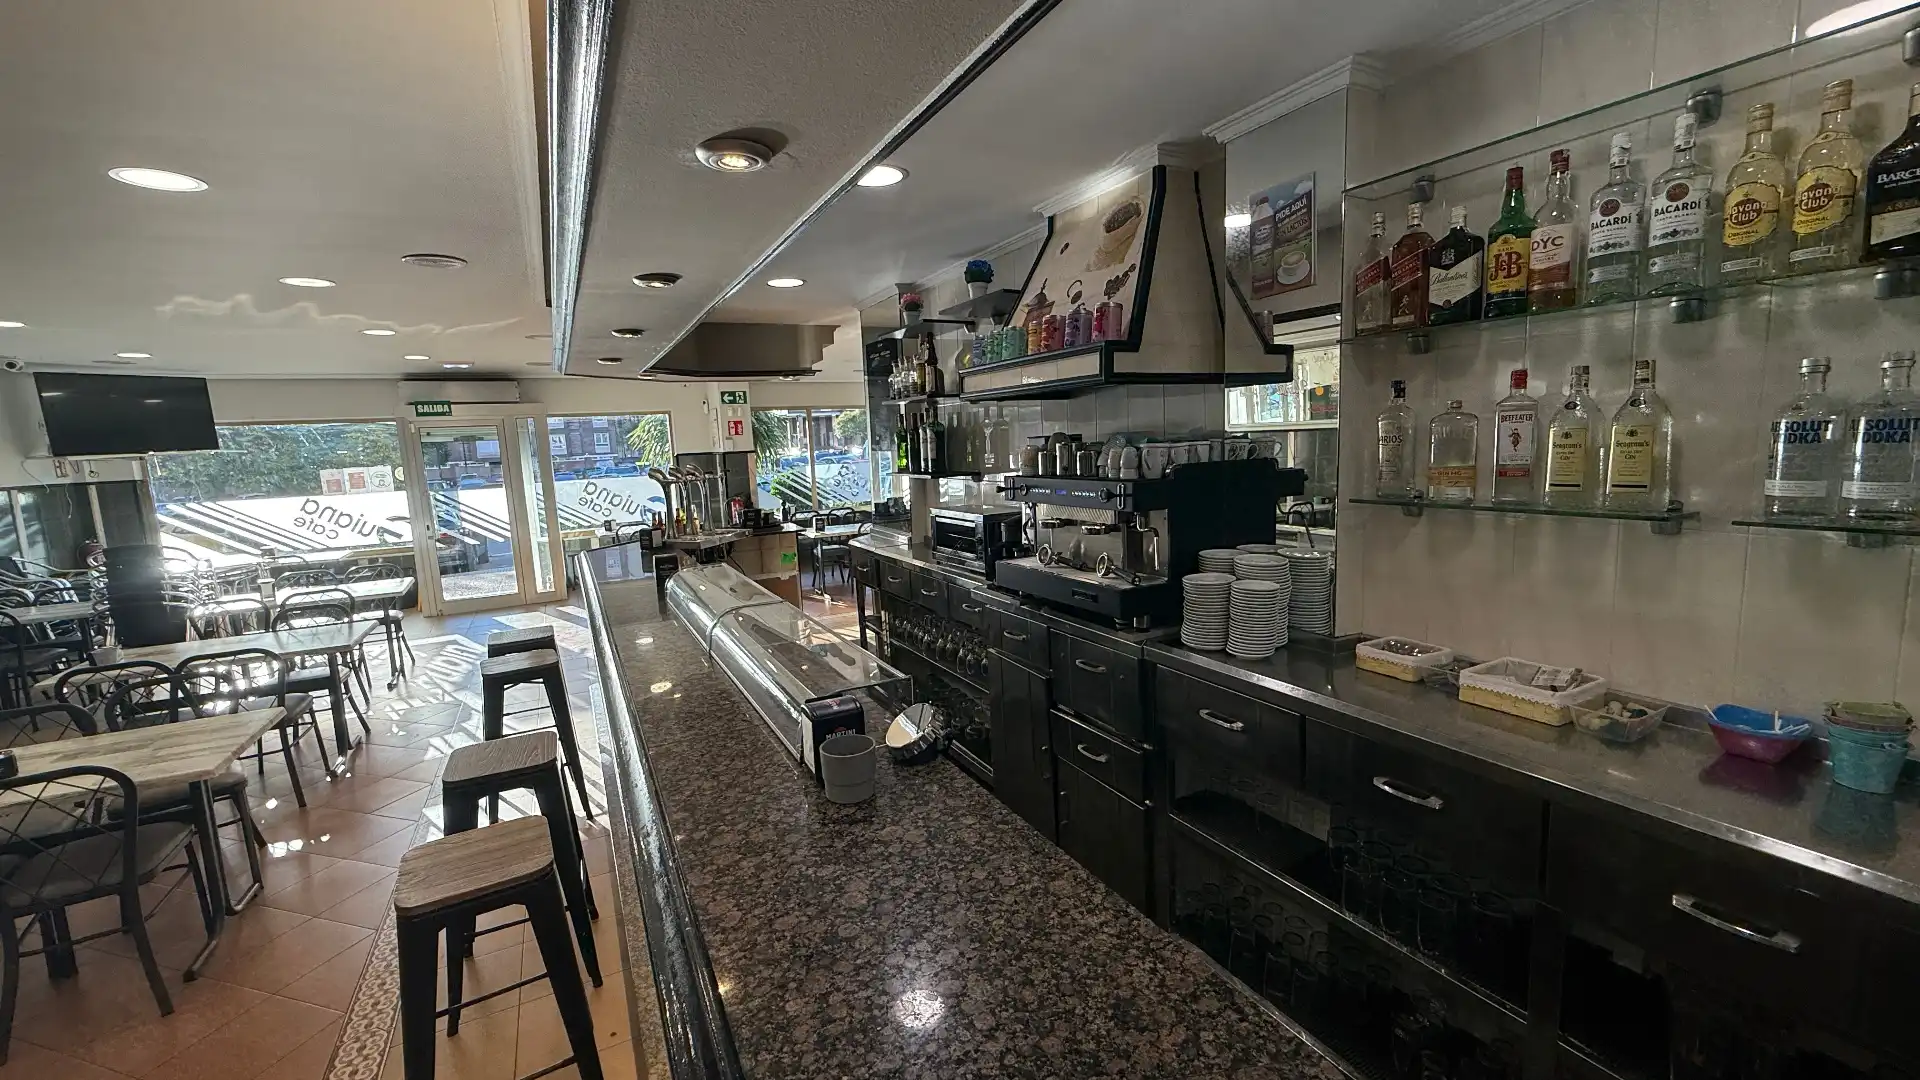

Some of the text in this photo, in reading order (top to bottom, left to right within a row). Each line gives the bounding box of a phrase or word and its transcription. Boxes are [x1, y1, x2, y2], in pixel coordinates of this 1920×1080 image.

[1801, 196, 1828, 210] Club
[1275, 207, 1290, 222] PIDE
[1731, 210, 1757, 223] Club
[1590, 212, 1632, 232] BACARDÍ
[1531, 235, 1565, 252] DYC
[416, 404, 450, 413] SALIDA
[1500, 413, 1533, 424] BEEFEATER
[1552, 442, 1582, 450] Seagram's
[1615, 440, 1650, 449] Seagram's
[825, 728, 856, 740] MARTINI
